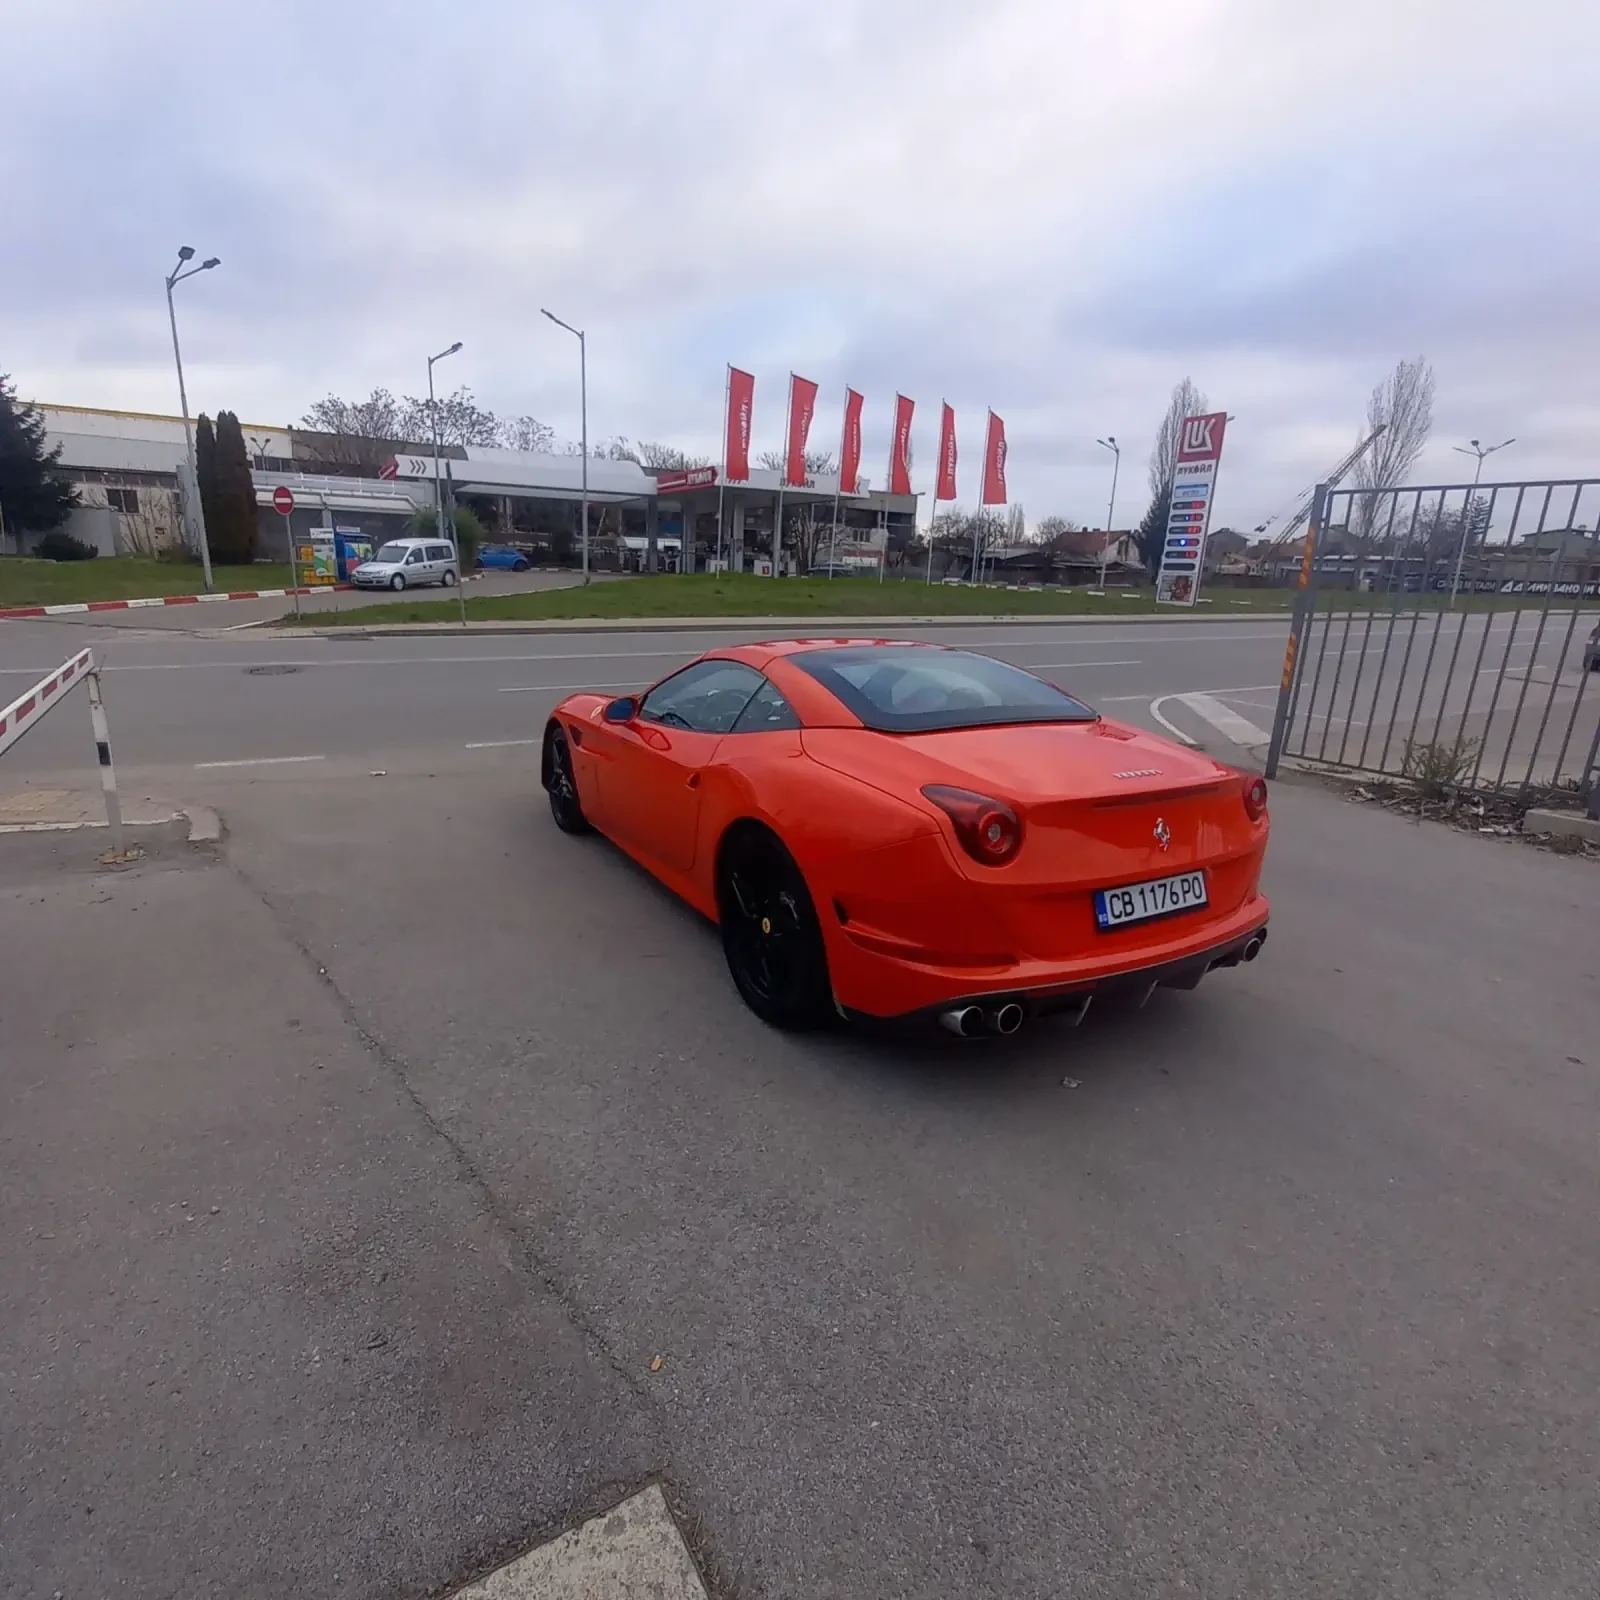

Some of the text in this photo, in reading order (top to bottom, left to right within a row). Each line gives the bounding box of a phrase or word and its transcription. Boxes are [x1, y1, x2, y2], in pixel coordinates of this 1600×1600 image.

[1109, 876, 1203, 919] CB 1176 PO
